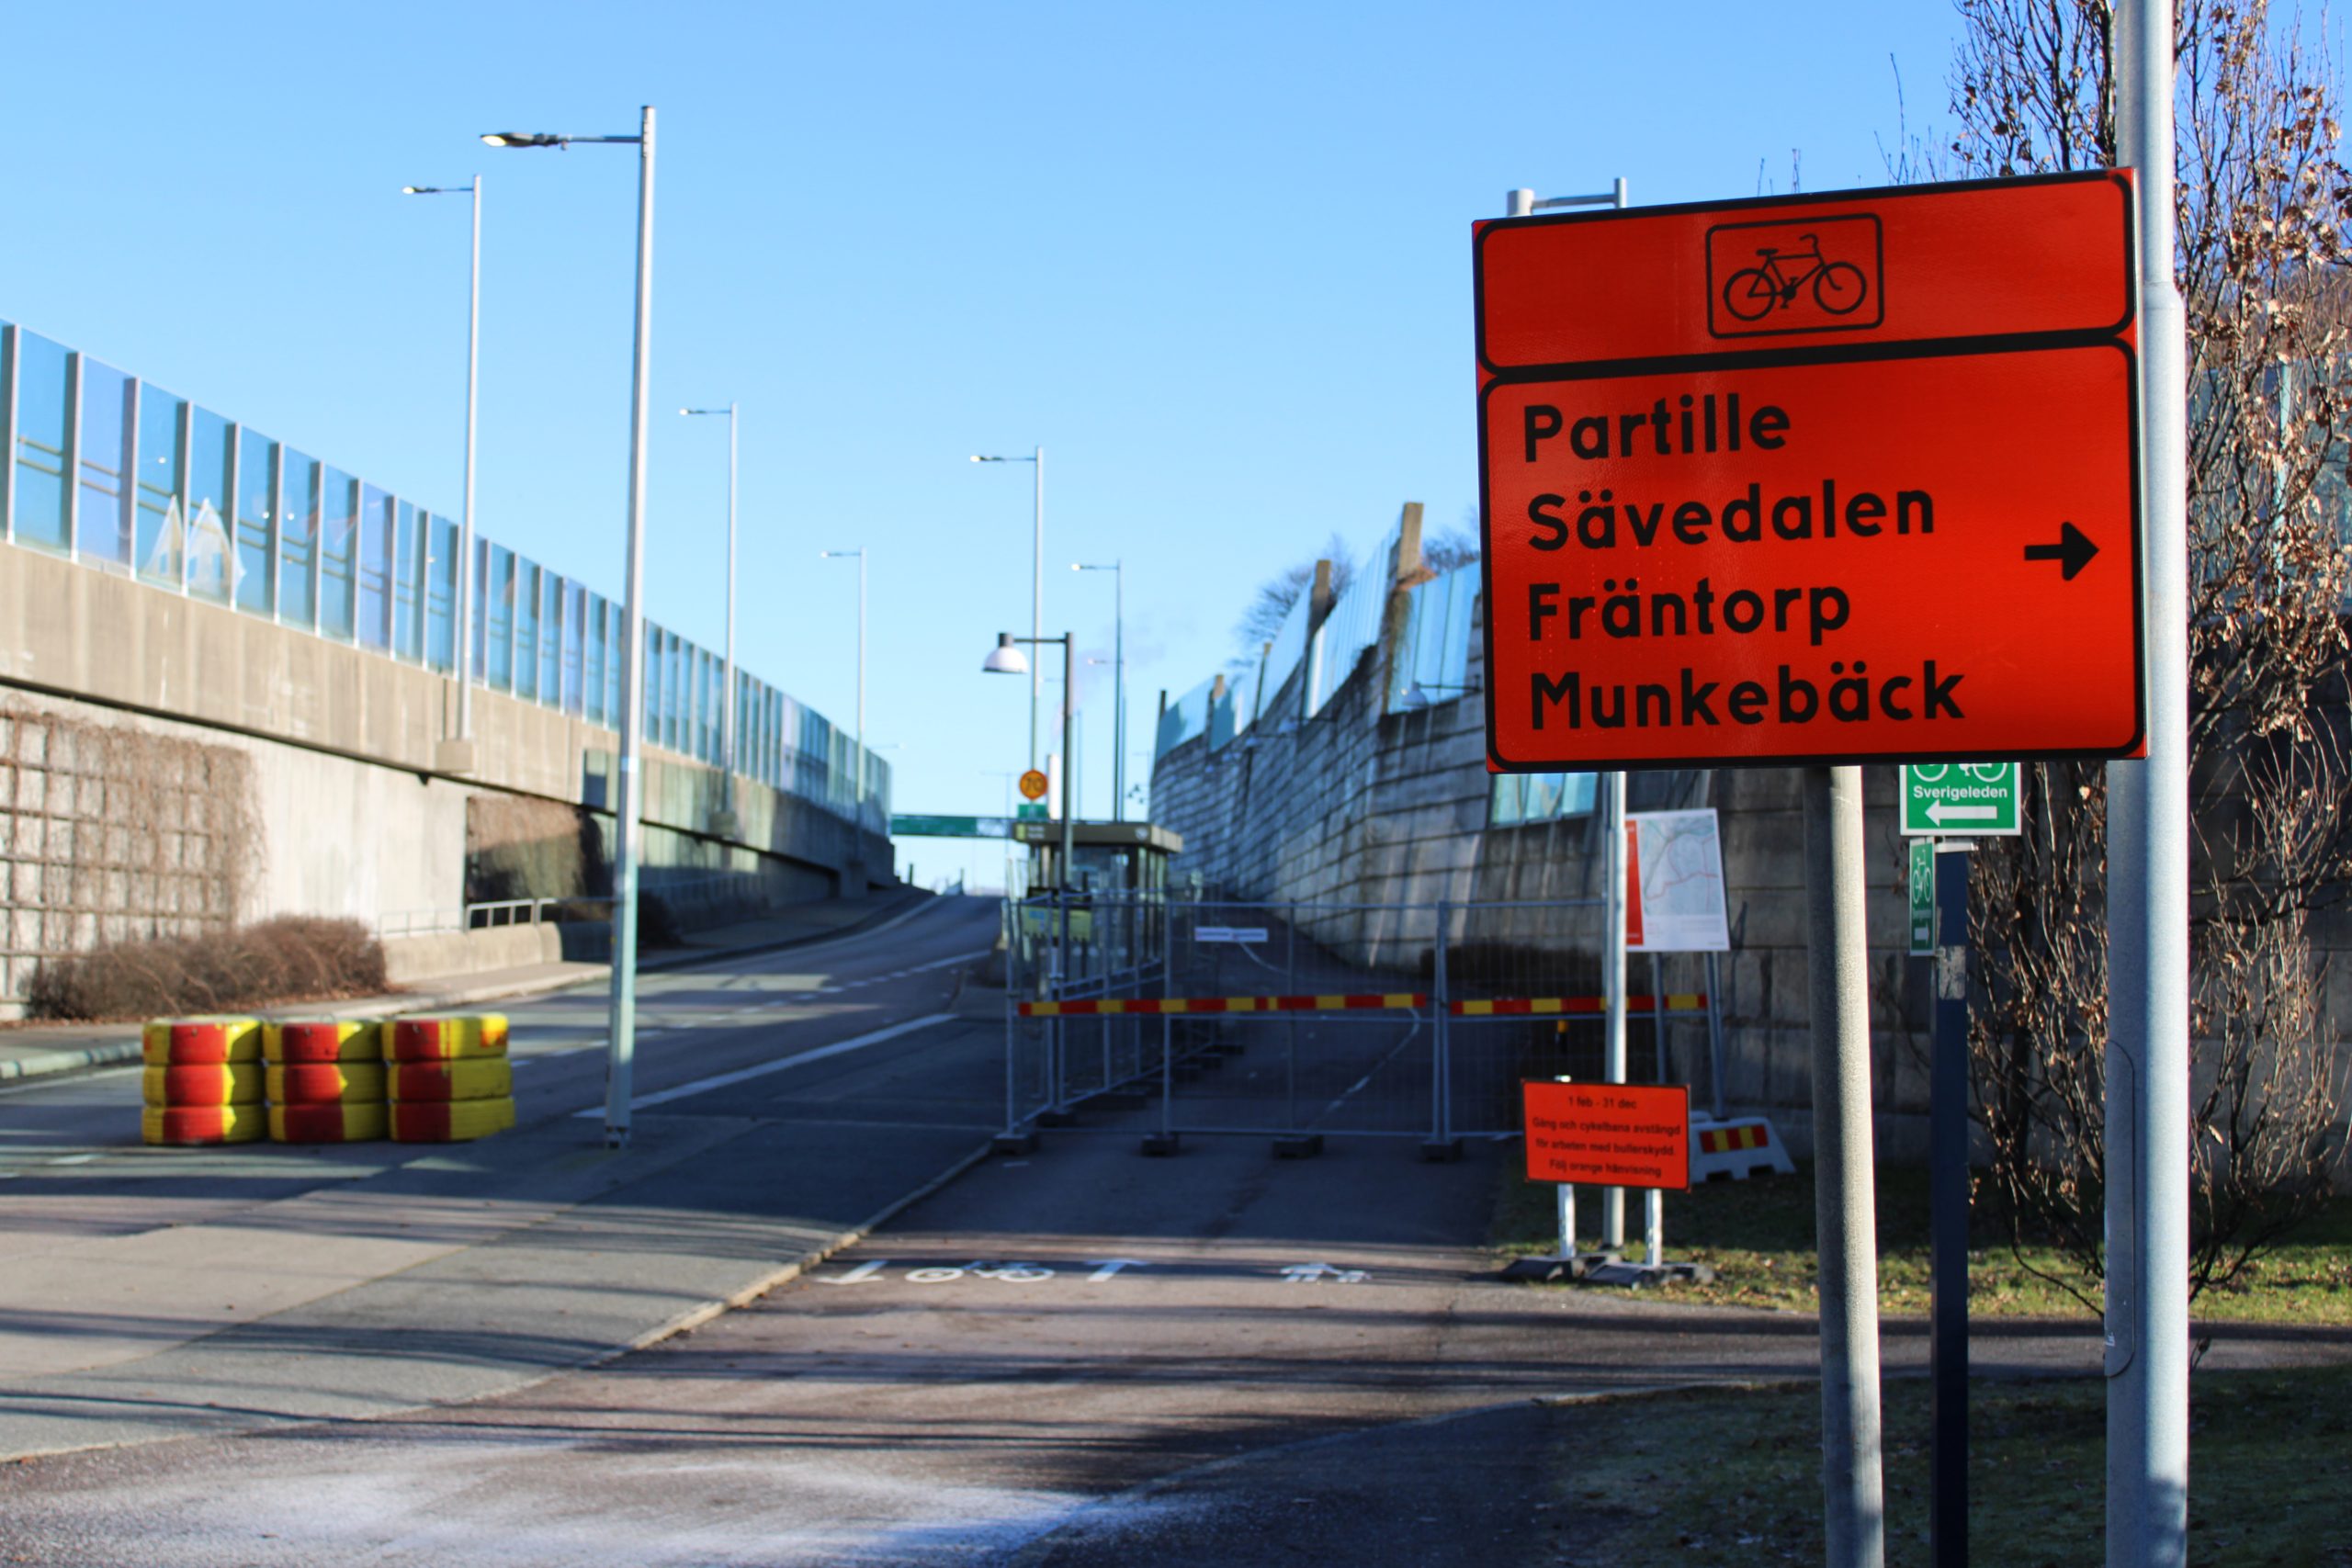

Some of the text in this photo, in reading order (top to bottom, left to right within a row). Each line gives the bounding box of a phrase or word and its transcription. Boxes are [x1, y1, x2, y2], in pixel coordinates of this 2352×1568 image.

[1524, 392, 1791, 463] Partille
[1528, 479, 1934, 552] Sävedalen
[1528, 577, 1850, 647] Fräntorp
[1531, 660, 1965, 731] Munkebäck
[1913, 784, 2008, 802] Sverigeleden
[1577, 1097, 1593, 1108] feb
[1618, 1099, 1637, 1110] dec
[1559, 1121, 1577, 1130] och
[1579, 1122, 1631, 1134] cykelbana
[1634, 1123, 1680, 1137] avstängd
[1589, 1143, 1611, 1153] med
[1569, 1163, 1603, 1175] orange
[1606, 1163, 1662, 1179] hänvisning
